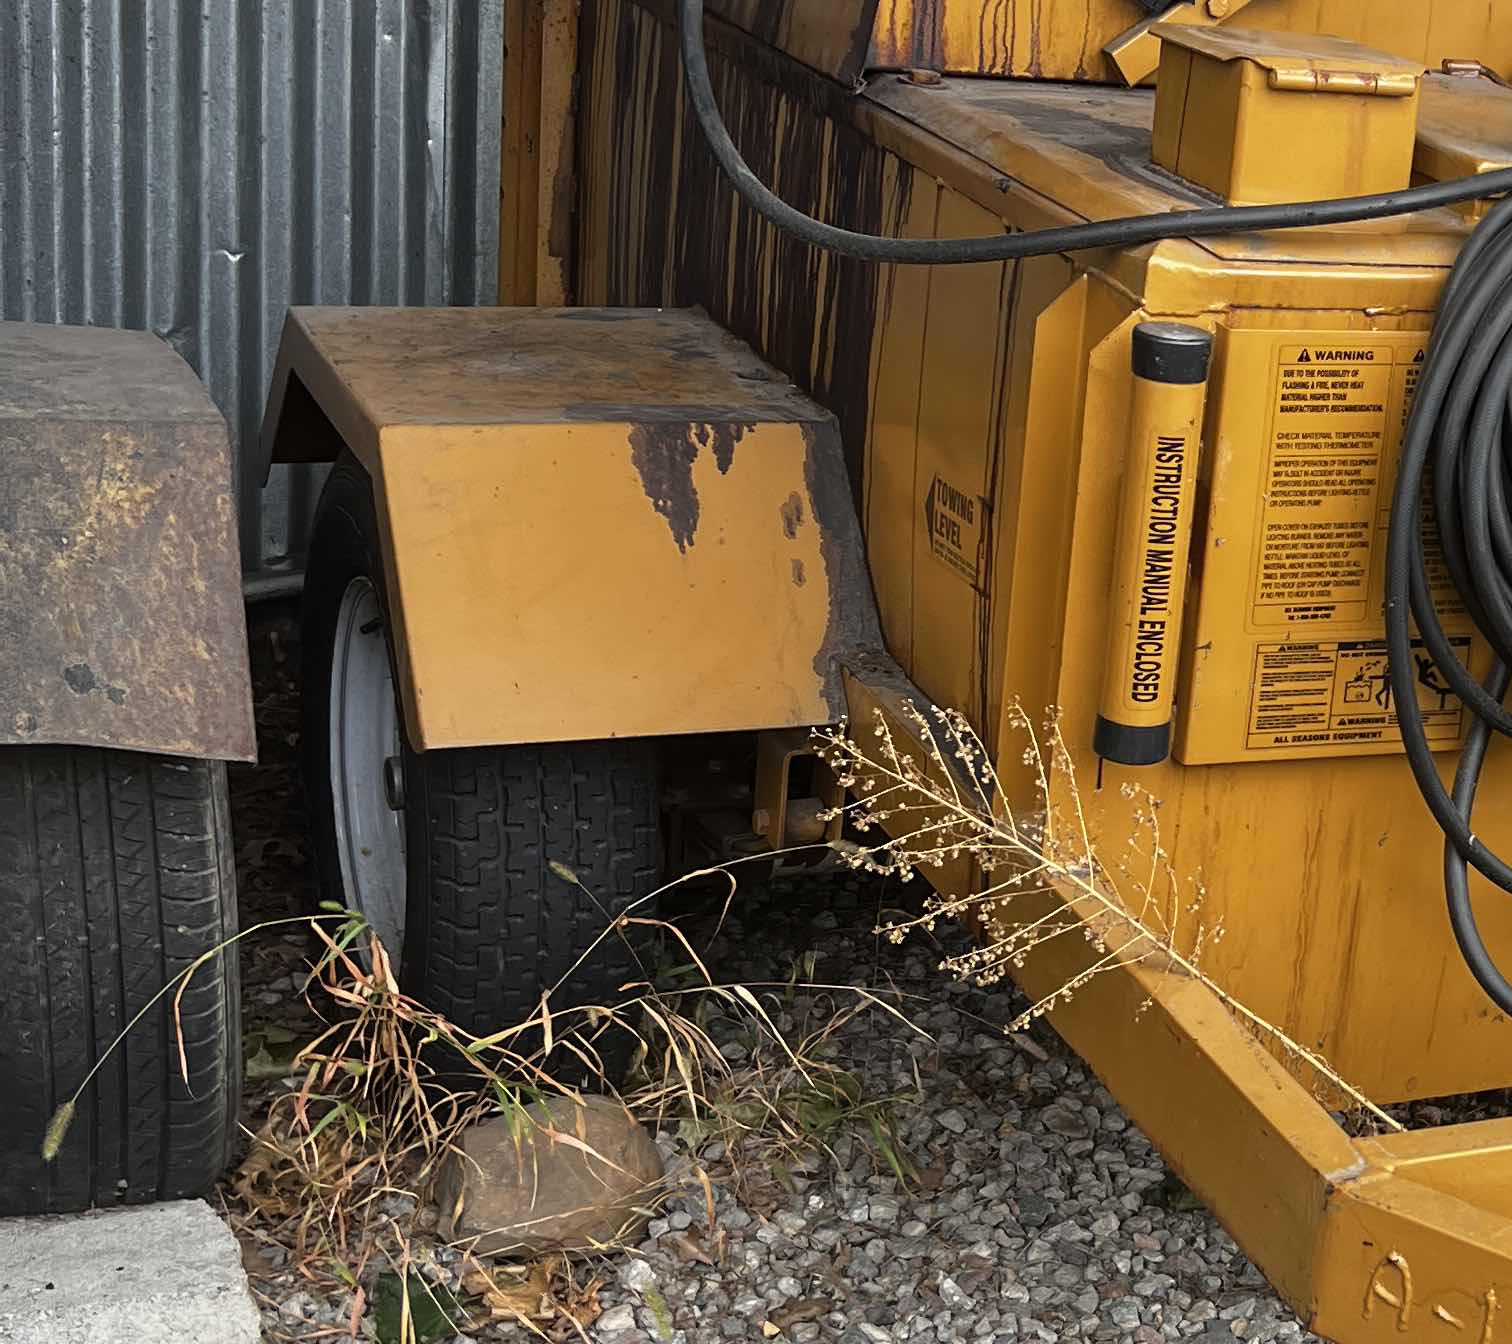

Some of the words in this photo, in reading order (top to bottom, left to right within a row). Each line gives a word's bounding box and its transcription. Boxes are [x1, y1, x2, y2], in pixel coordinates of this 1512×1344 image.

[1315, 350, 1374, 361] WARNING
[936, 477, 974, 525] TOWING
[1148, 436, 1185, 545] INSTRUCTION
[935, 508, 962, 551] LEVEL
[1140, 549, 1174, 615] MANUAL
[1131, 620, 1166, 703] ENCLOSED
[1274, 736, 1290, 744] ALL
[1291, 734, 1330, 743] SEASONS
[1332, 731, 1383, 741] EQUIPMENT
